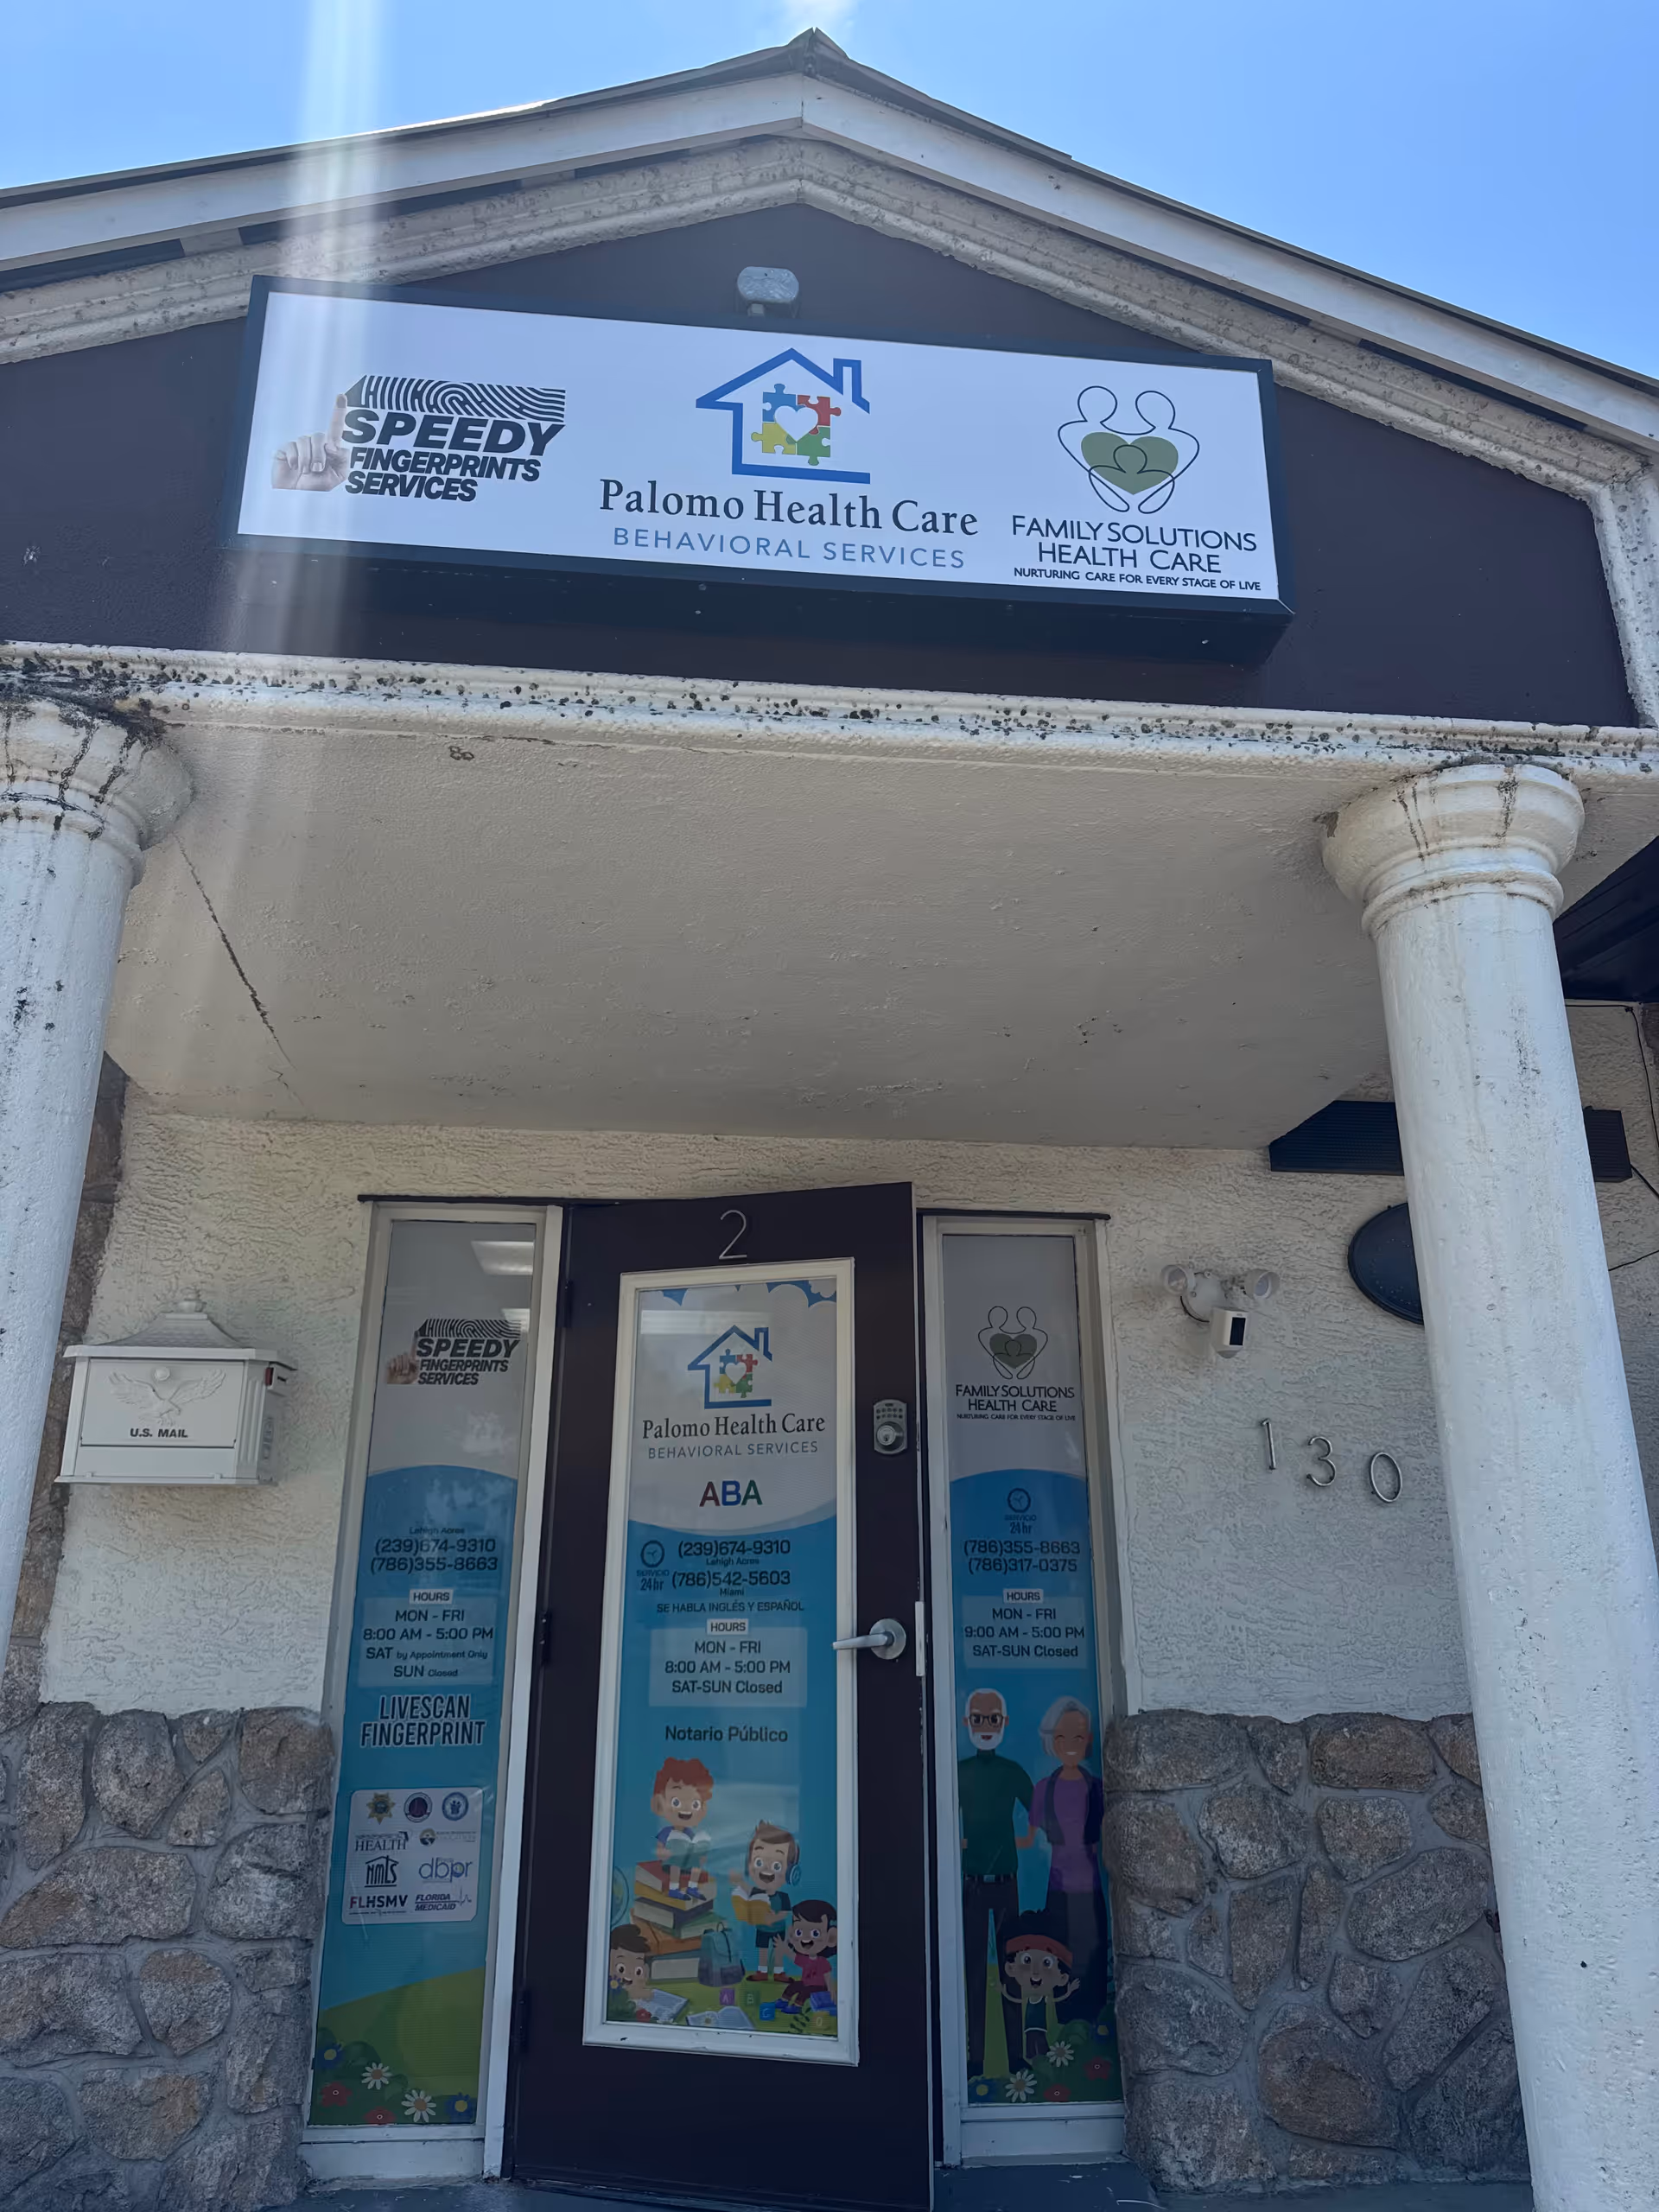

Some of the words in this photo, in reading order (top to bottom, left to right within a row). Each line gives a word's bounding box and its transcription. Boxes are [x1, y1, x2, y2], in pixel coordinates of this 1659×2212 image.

[341, 410, 565, 456] SPEEDY
[349, 448, 541, 481] FINGERPRINTS
[346, 471, 476, 502] SERVICES
[600, 479, 744, 519] Palomo
[753, 489, 882, 529] Health
[892, 499, 979, 536] Care
[613, 527, 810, 559] BEHAVIORAL
[823, 542, 964, 569] SERVICES
[1039, 542, 1137, 568] HEALTH
[1149, 550, 1221, 573] CARE
[1014, 568, 1080, 580] NURTURING
[1085, 572, 1116, 582] CARE
[1119, 574, 1143, 583] FOR
[1147, 575, 1179, 586] EVERY
[1182, 578, 1217, 588] STAGE
[1220, 580, 1236, 589] OF
[1239, 582, 1261, 591] LIVE
[719, 1210, 747, 1260] 2
[416, 1338, 520, 1357] SPEEDY
[420, 1359, 508, 1372] FINGERPRINTS
[418, 1372, 479, 1385] SERVICES
[968, 1398, 1016, 1411] HEALTH
[1021, 1400, 1058, 1412] CARE
[130, 1428, 153, 1438] U.S.
[158, 1429, 188, 1438] MAIL
[642, 1417, 710, 1440] Palomo
[714, 1414, 778, 1436] Health
[781, 1413, 826, 1433] Care
[648, 1444, 742, 1459] BEHAVIORAL
[747, 1440, 818, 1456] SERVICES
[699, 1479, 763, 1507] ABA
[375, 1538, 496, 1555] (239)674-9310
[678, 1539, 791, 1558] (239)674-9310
[964, 1540, 1080, 1555] (786)355-8663
[372, 1557, 498, 1574] (786)355-8663
[706, 1558, 734, 1567] Lehigh
[969, 1558, 1077, 1575] (786)317-0375
[671, 1570, 791, 1589] (786)542-5603
[413, 1592, 449, 1601] HOURS
[719, 1588, 744, 1597] Miami
[1007, 1592, 1040, 1601] HOURS
[657, 1604, 670, 1612] SE
[672, 1603, 706, 1612] HABLA
[709, 1600, 745, 1611] INGLÉS
[748, 1602, 755, 1611] Y
[757, 1600, 804, 1611] ESPAÑOL
[395, 1610, 428, 1622] MON
[442, 1610, 465, 1621] FRI
[992, 1608, 1023, 1620] MON
[1035, 1608, 1057, 1620] FRI
[363, 1629, 396, 1640] 8:00
[399, 1628, 422, 1640] AM
[435, 1628, 467, 1639] 5:00
[473, 1628, 493, 1639] PM
[710, 1622, 746, 1632] HOURS
[964, 1626, 995, 1638] 9:00
[999, 1626, 1019, 1638] AM
[1032, 1626, 1061, 1638] 5:00
[1065, 1626, 1084, 1638] PM
[365, 1647, 393, 1659] SAT
[410, 1651, 465, 1660] Appointment
[467, 1650, 488, 1659] Only
[694, 1641, 726, 1653] MON
[739, 1640, 761, 1653] FRI
[973, 1645, 1030, 1657] SAT-SUN
[1034, 1645, 1078, 1657] Closed
[393, 1665, 424, 1677] SUN
[664, 1661, 696, 1674] 8:00
[700, 1661, 721, 1673] AM
[734, 1661, 766, 1673] 5:00
[769, 1660, 791, 1673] PM
[671, 1680, 732, 1694] SAT-SUN
[735, 1680, 783, 1694] Closed
[380, 1695, 470, 1719] LIVESCAN
[361, 1721, 486, 1746] FINGERPRINT
[665, 1726, 723, 1741] Notario
[728, 1724, 788, 1742] Público
[355, 1840, 406, 1852] HEALTH
[418, 1858, 473, 1883] dbpr
[349, 1895, 408, 1909] FLHSMV
